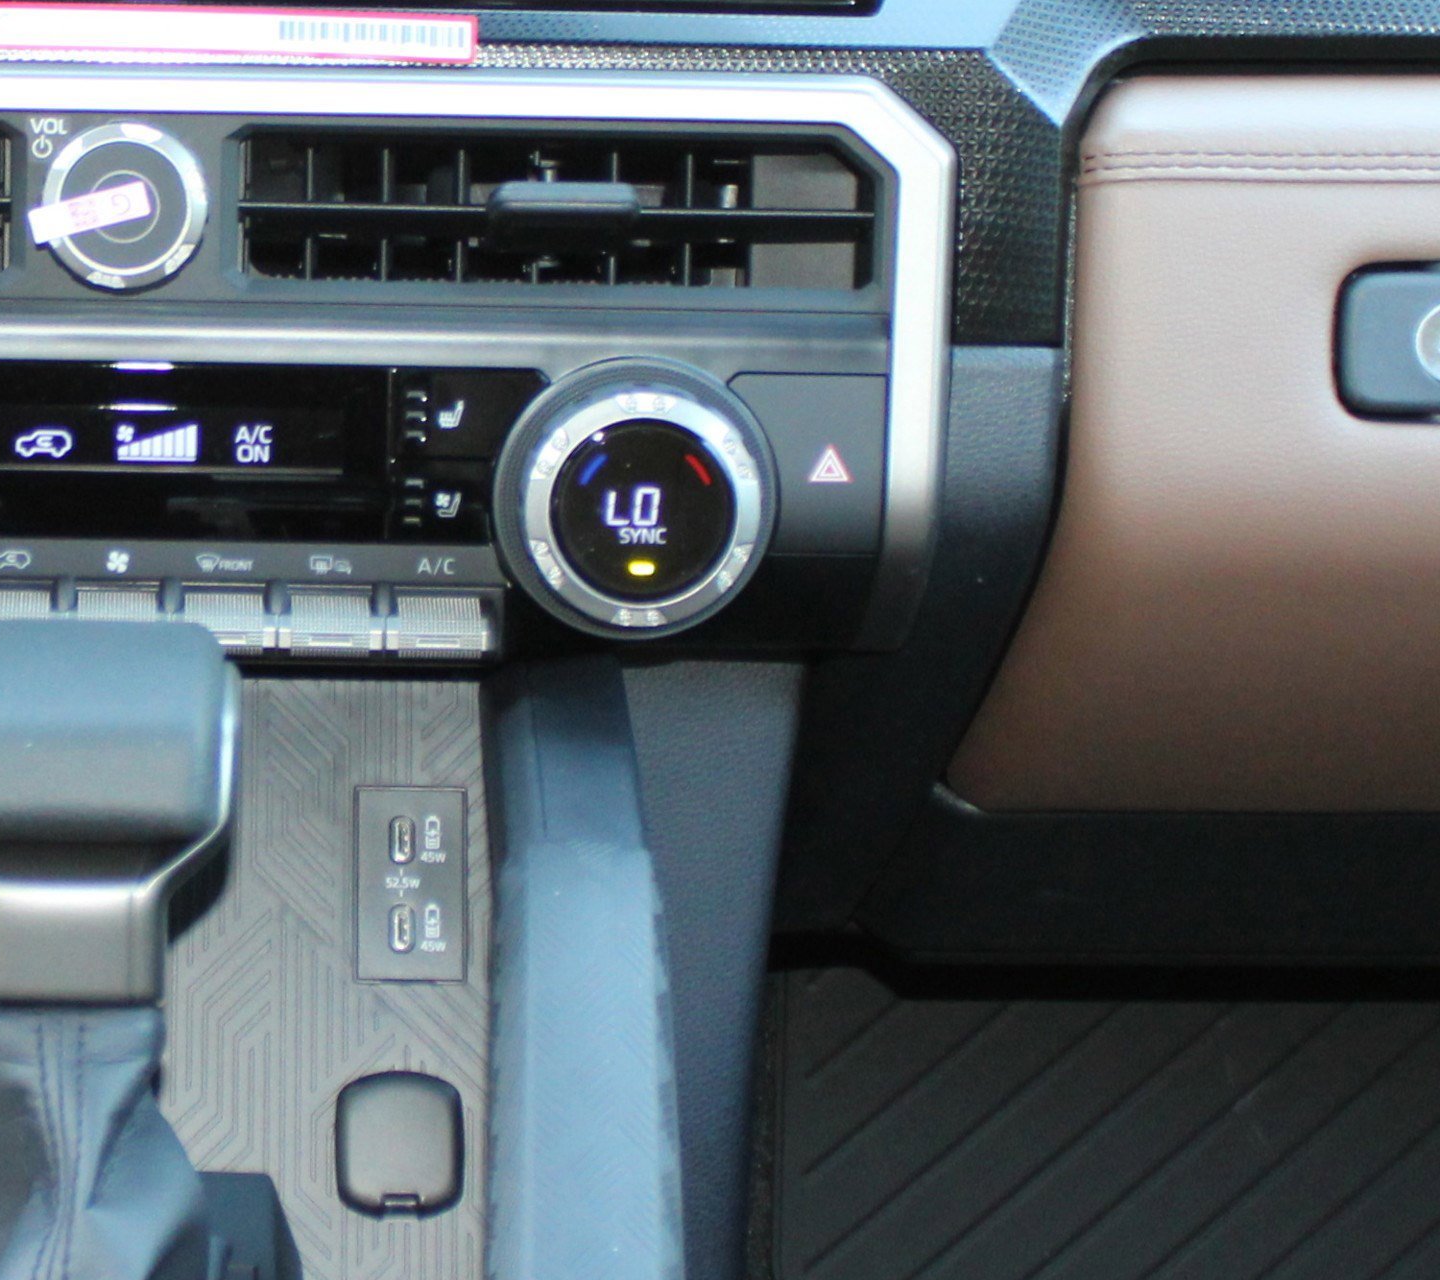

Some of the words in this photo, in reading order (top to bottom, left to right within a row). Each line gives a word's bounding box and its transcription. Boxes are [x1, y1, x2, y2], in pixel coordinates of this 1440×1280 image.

[30, 118, 68, 135] VOL
[235, 425, 273, 445] A/C
[236, 445, 270, 463] ON
[605, 486, 661, 527] LO
[619, 527, 668, 545] SYNC
[219, 559, 255, 572] FRONT
[416, 557, 456, 576] A/C
[420, 852, 447, 864] 45W
[385, 877, 421, 889] 52.5W
[420, 941, 447, 953] 45W
